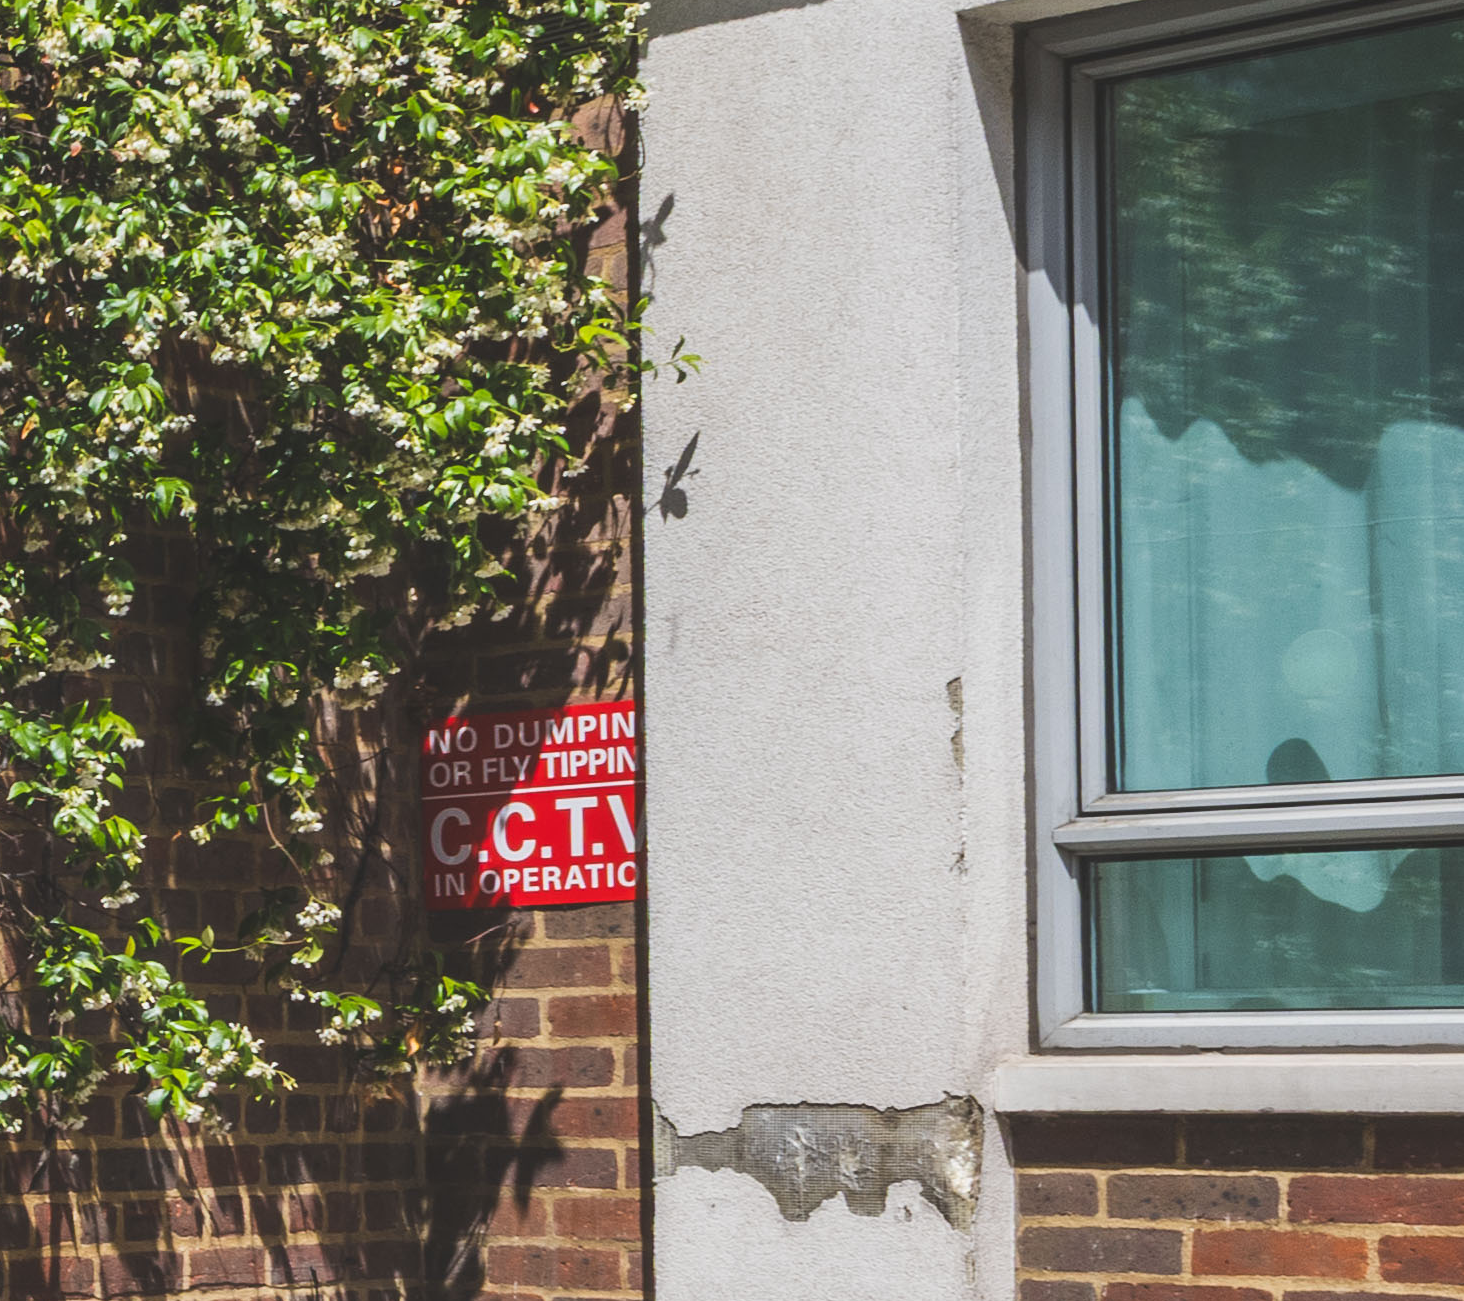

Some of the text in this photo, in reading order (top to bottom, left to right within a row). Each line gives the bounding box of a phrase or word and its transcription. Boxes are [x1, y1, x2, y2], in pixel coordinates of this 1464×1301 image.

[427, 710, 636, 756] NO DUMPIN
[428, 745, 639, 788] OR FLY TIPPIN
[434, 861, 639, 897] IN OPERATIO
